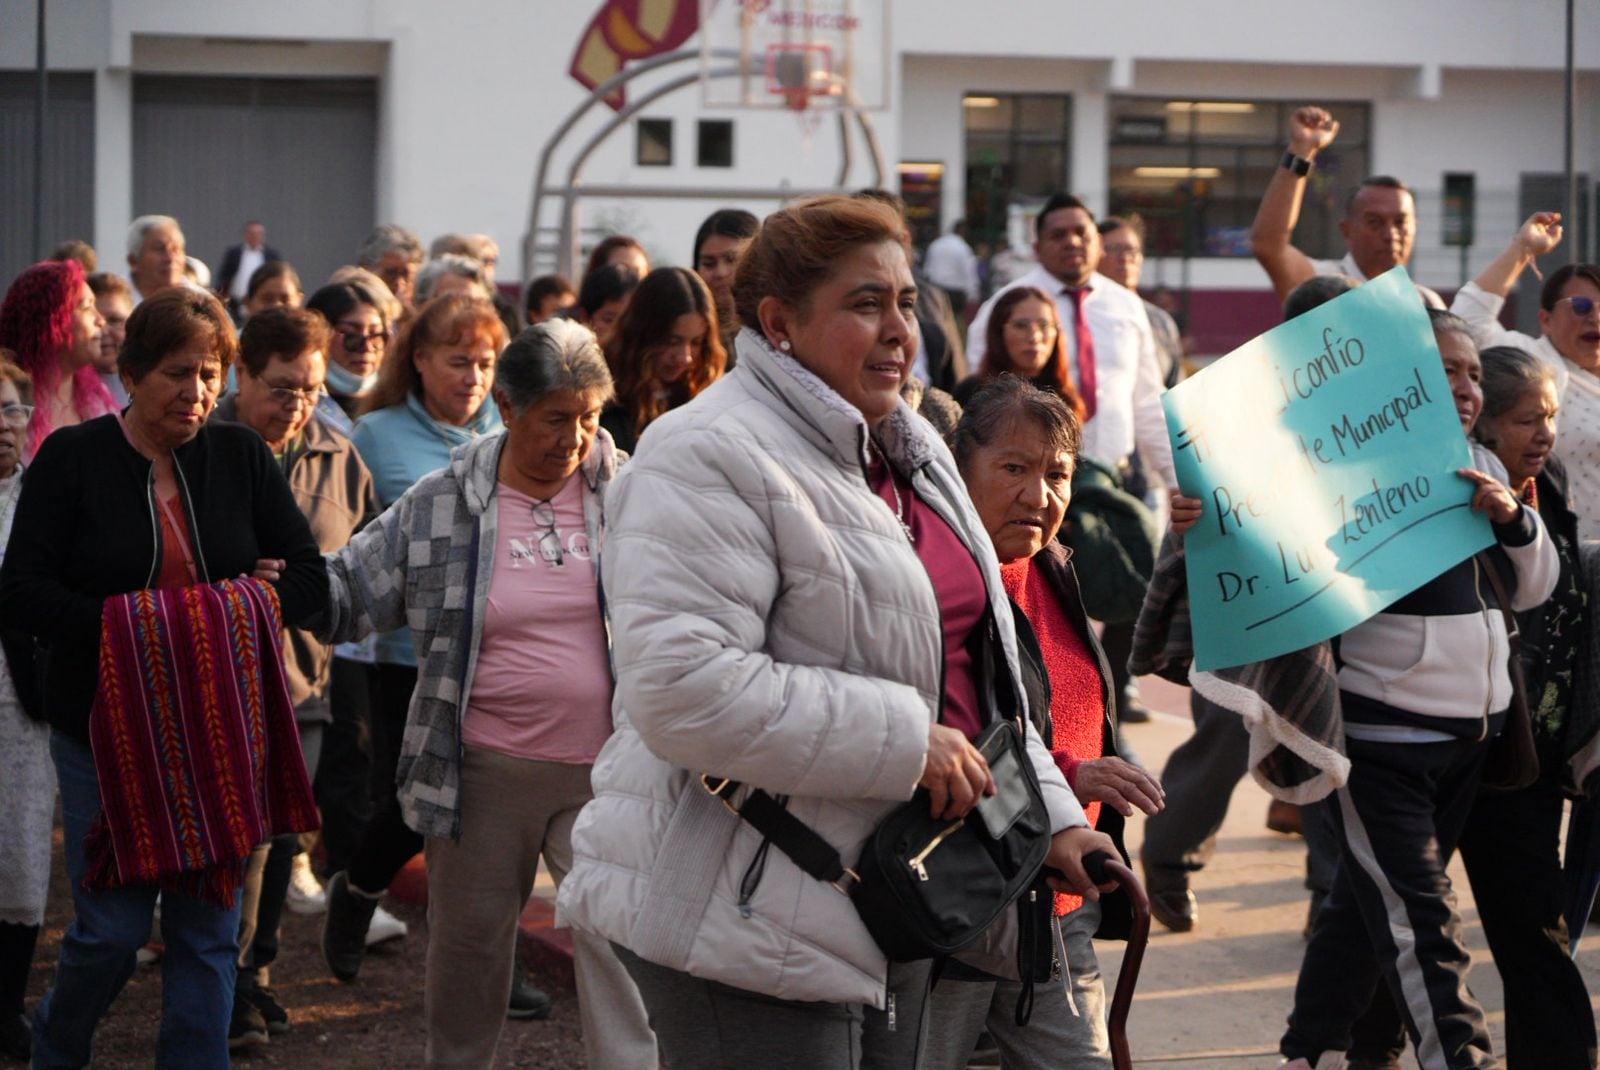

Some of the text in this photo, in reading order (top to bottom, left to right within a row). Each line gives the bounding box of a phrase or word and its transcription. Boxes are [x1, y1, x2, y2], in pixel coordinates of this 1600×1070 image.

[1331, 367, 1433, 456] Municipal
[1216, 475, 1431, 602] Dr. Lu Zenteno
